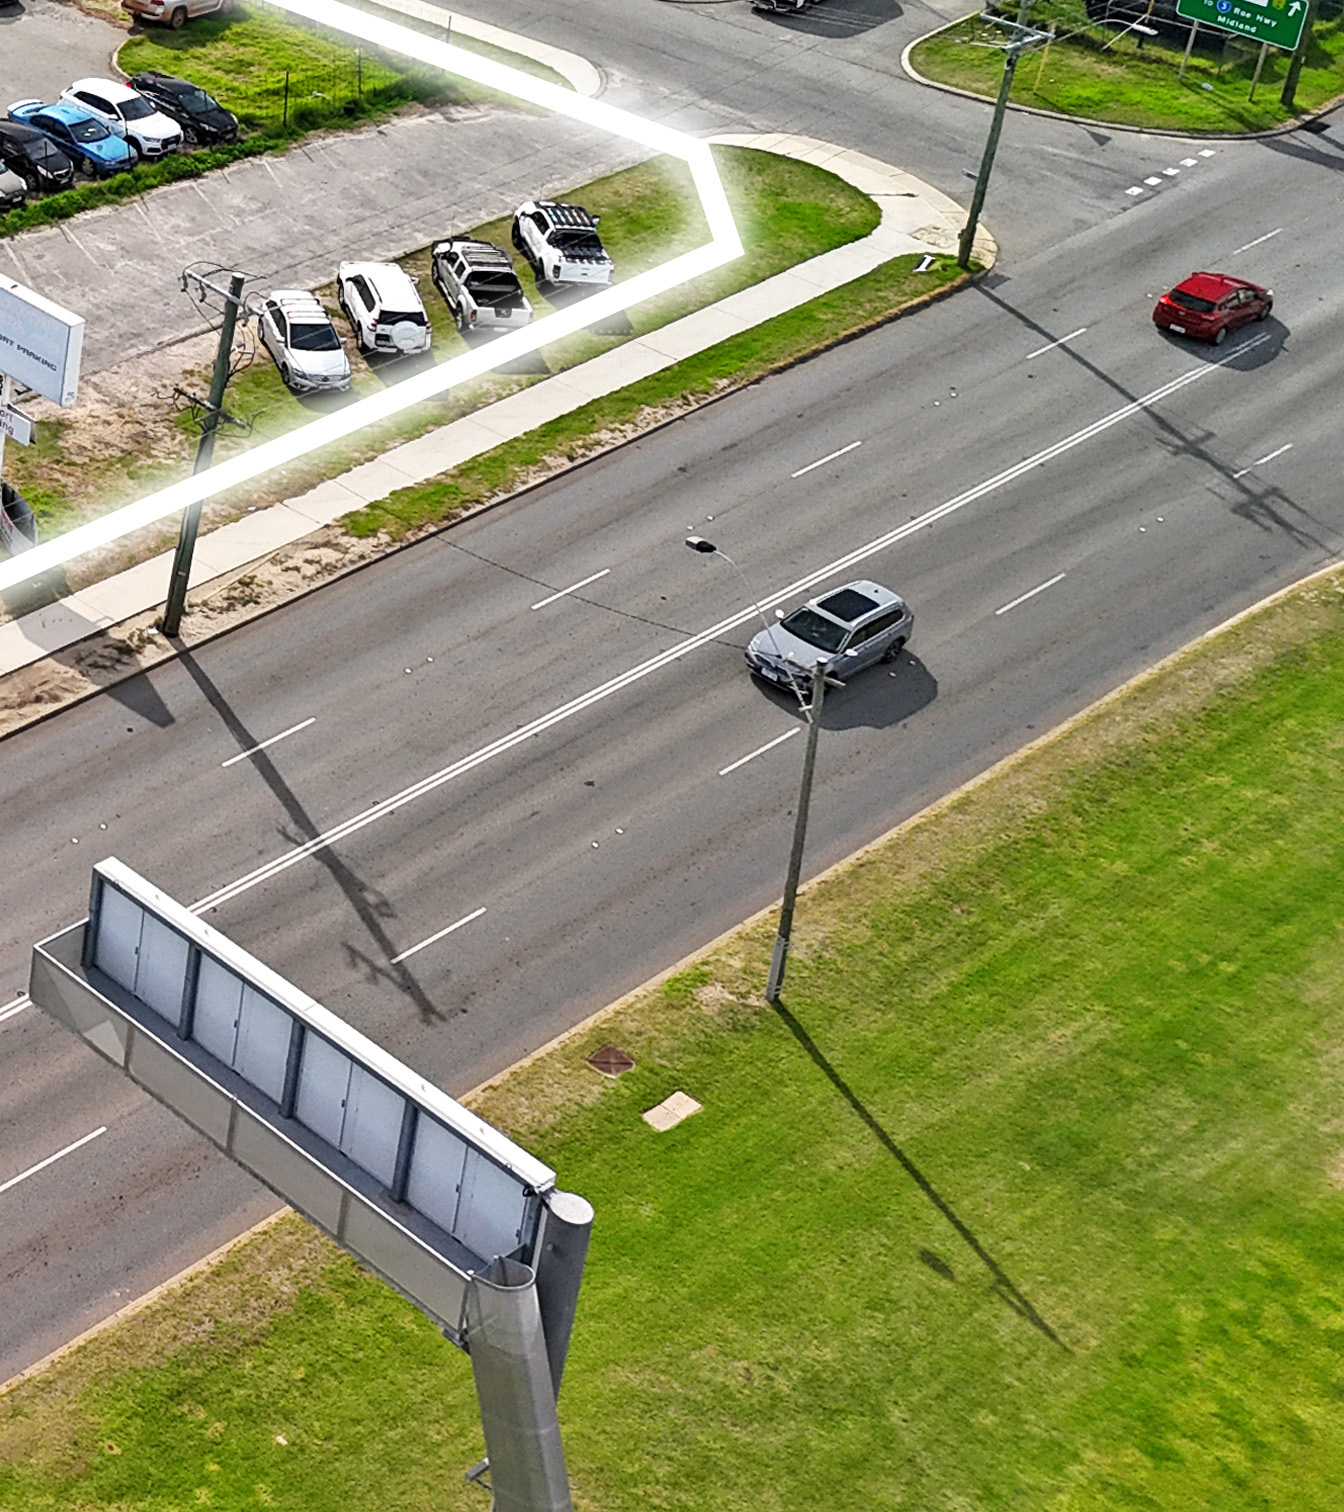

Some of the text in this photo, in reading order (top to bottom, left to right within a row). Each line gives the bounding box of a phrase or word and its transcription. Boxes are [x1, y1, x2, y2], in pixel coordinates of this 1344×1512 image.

[1217, 15, 1257, 33] Midland
[1255, 14, 1278, 28] Hwy
[16, 344, 58, 372] PARKING
